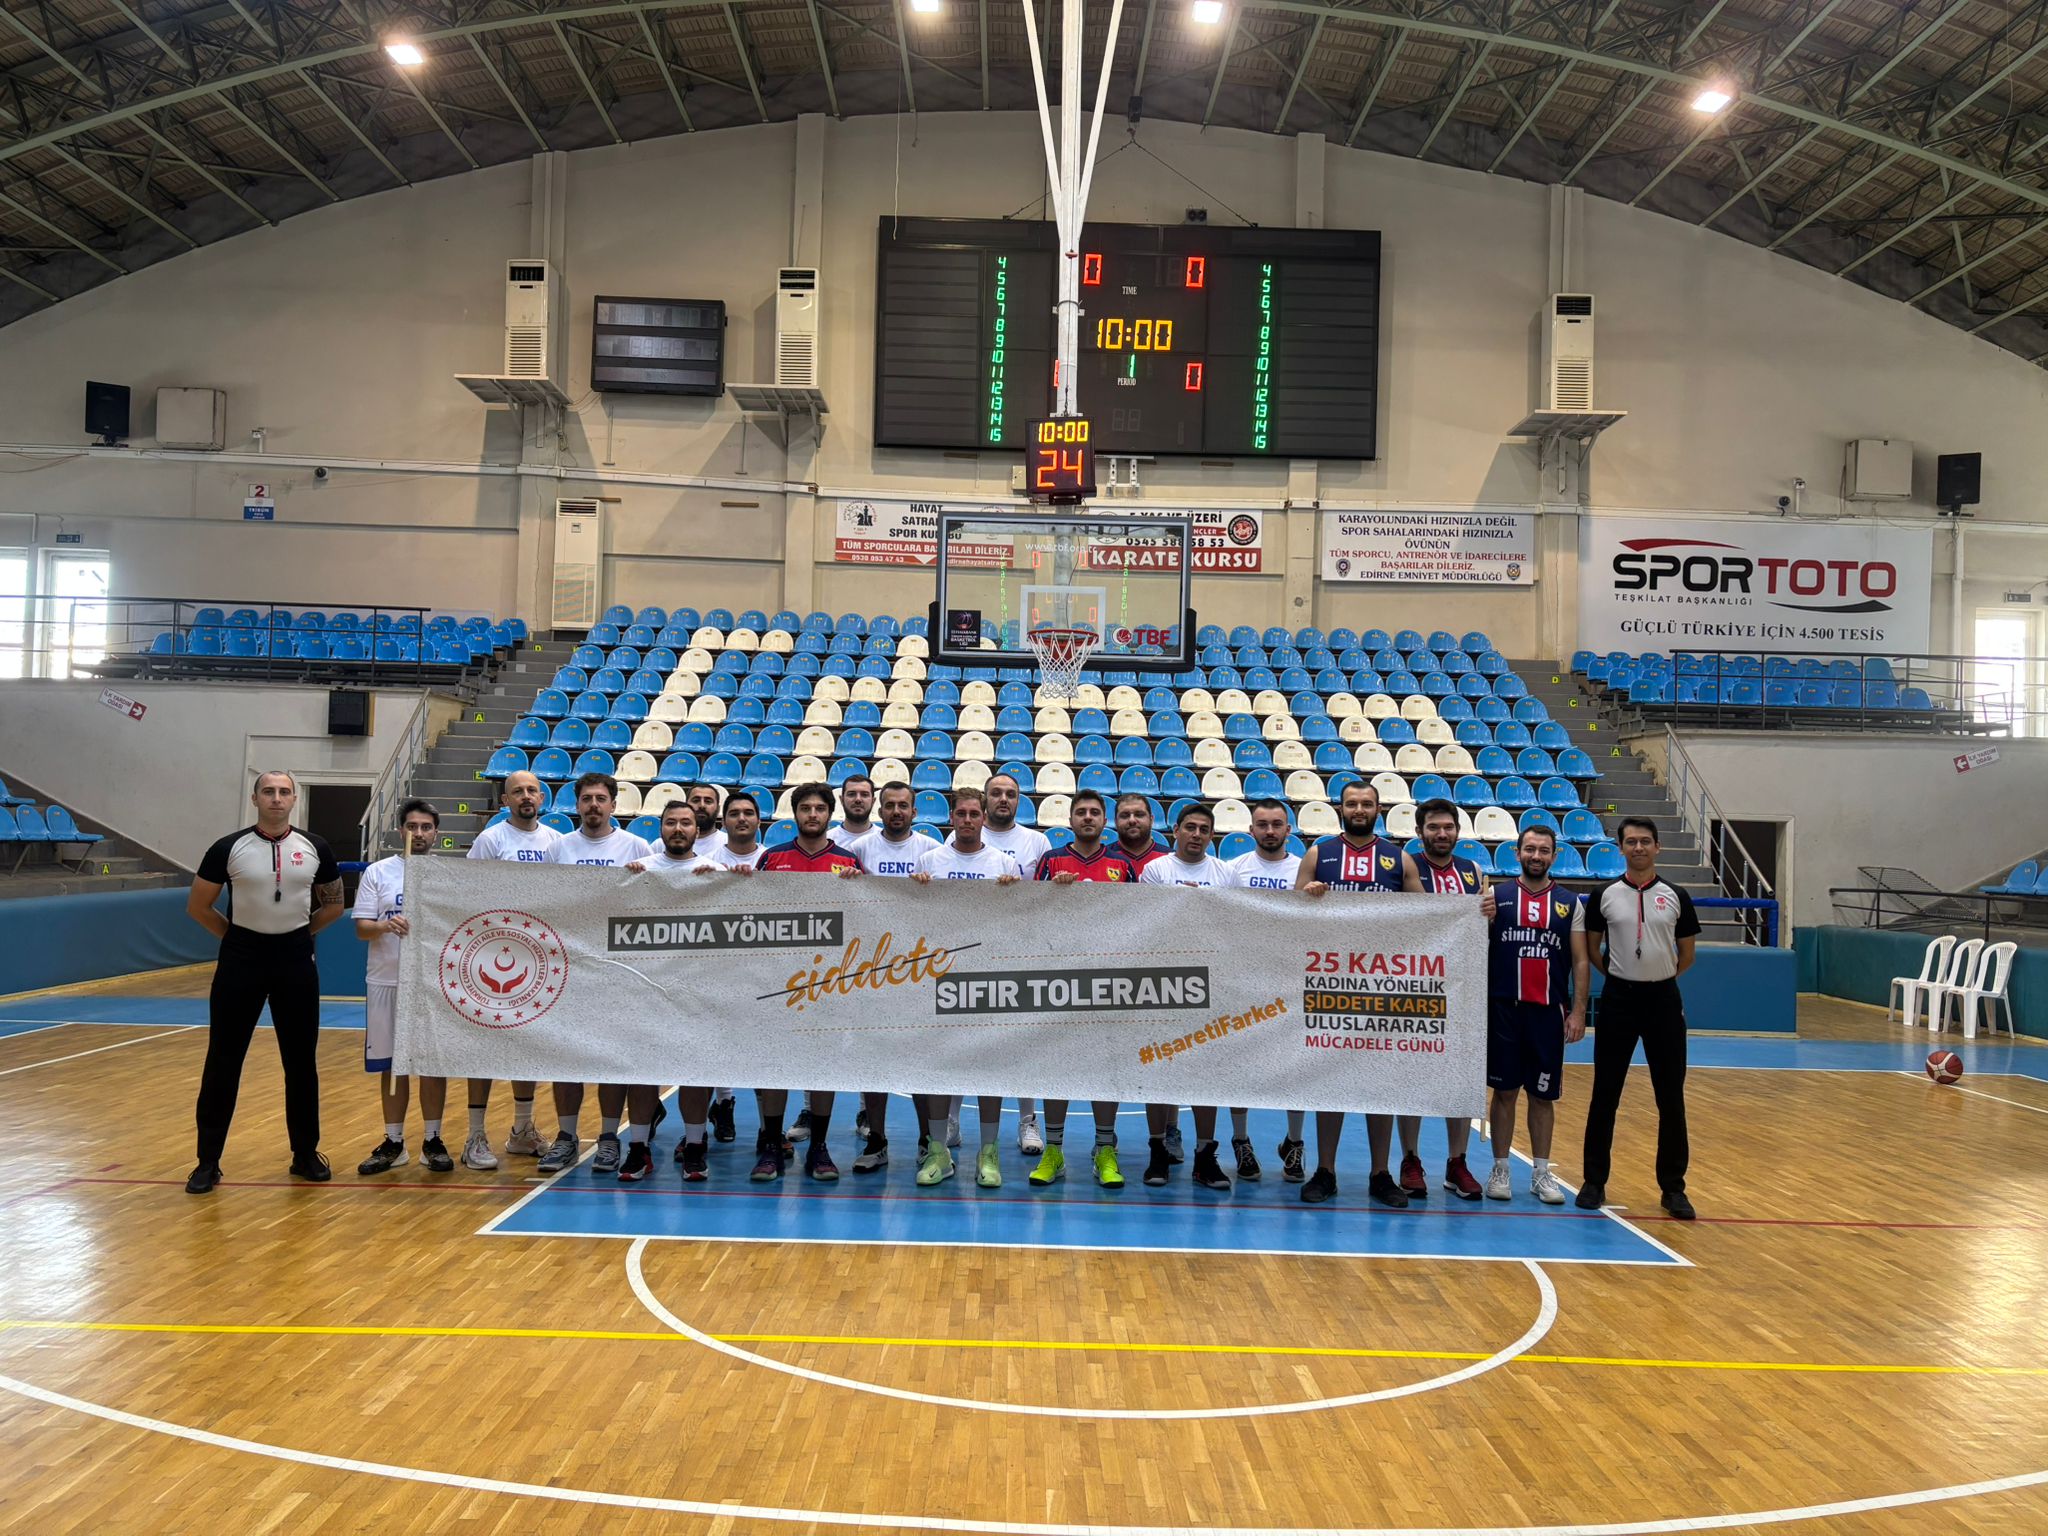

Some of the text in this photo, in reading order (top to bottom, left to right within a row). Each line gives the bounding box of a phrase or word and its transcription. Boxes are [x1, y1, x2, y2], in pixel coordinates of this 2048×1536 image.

[999, 256, 1006, 268] 4
[1083, 253, 1102, 284] 0
[1186, 256, 1204, 288] 0
[1263, 264, 1271, 276] 4
[998, 272, 1006, 284] 5
[1122, 286, 1137, 295] TIME
[1262, 280, 1270, 292] 5
[996, 288, 1005, 300] 6
[1261, 295, 1270, 308] 6
[998, 303, 1005, 316] 7
[1263, 310, 1270, 323] 7
[996, 318, 1004, 332] 8
[1097, 318, 1172, 350] 10:00
[1261, 326, 1270, 339] 8
[996, 334, 1004, 348] 9
[1261, 341, 1269, 355] 9
[992, 350, 1004, 363] 10
[1128, 354, 1136, 378] 1
[1257, 357, 1268, 370] 10
[992, 366, 1003, 378] 11
[1185, 363, 1202, 390] 0
[1117, 378, 1136, 386] PERIOD
[1257, 373, 1268, 385] 11
[992, 382, 1003, 394] 12
[1256, 389, 1268, 401] 12
[991, 397, 1002, 410] 13
[1256, 404, 1267, 417] 13
[990, 413, 1002, 426] 14
[1038, 421, 1088, 442] 10:00
[1255, 420, 1267, 433] 14
[990, 428, 1001, 442] 15
[1254, 436, 1266, 449] 15
[1037, 450, 1082, 487] 24
[255, 486, 264, 497] 2
[910, 504, 944, 513] HAYAT
[902, 516, 938, 526] SATRA
[1338, 514, 1517, 527] KARAYOLUNDAKİ HIZINIZLA DEĞİL
[889, 528, 917, 538] SPOR
[1341, 527, 1513, 539] SPOR SAHALARINDAKİ HIZINIZLA
[842, 540, 1010, 556] TÜM SPORCULARA BARILAR DİLERİZ.
[1210, 538, 1225, 547] 53
[1405, 539, 1450, 550] ÖVÜNÜN
[1092, 550, 1257, 568] KARATE KURSU
[1330, 549, 1527, 561] TÜM SPORCU, ANTRENÖR VE İDARECİLERE
[1381, 561, 1475, 571] BAŞARILAR DİLERİZ.
[1360, 569, 1502, 581] EDİRNE EMNİYET MÜDÜRLÜĞÜ
[1614, 593, 1752, 606] TEŞKİLAT BAŞKANLIĞI
[1621, 619, 1884, 641] GÜÇLÜ TÜRKİYE İÇİN 4.500 TESİS
[1134, 629, 1171, 646] TBF
[475, 714, 483, 722] A
[1612, 748, 1620, 756] A
[459, 804, 467, 813] D
[443, 838, 452, 848] C
[517, 850, 545, 861] GEN
[1348, 856, 1369, 876] 15
[1328, 881, 1360, 891] imit
[1438, 875, 1458, 894] 13
[1528, 901, 1540, 922] 5
[614, 914, 833, 945] KADINA YÖNELİK
[1502, 927, 1536, 942] simit
[482, 932, 495, 942] AİLE
[506, 932, 532, 946] SOSYAL
[1518, 944, 1549, 958] cafe
[532, 944, 546, 981] HİZMETLER
[1305, 951, 1445, 977] 25 KASIM
[786, 931, 957, 1011] şiddete
[1305, 976, 1445, 993] KADINA YÖNELİK
[466, 982, 490, 1006] TÜRKİYE
[508, 980, 542, 1006] BAKANLIĞI
[937, 975, 1206, 1009] SIFIR TOLERANS
[1305, 991, 1445, 1016] ŞİDDETE KARŞI
[1138, 996, 1288, 1064] #işaretiFarket
[1305, 1015, 1445, 1034] ULUSLARARASI
[1306, 1033, 1444, 1053] MÜCADELE GÜNÜ
[1537, 1072, 1551, 1092] 5
